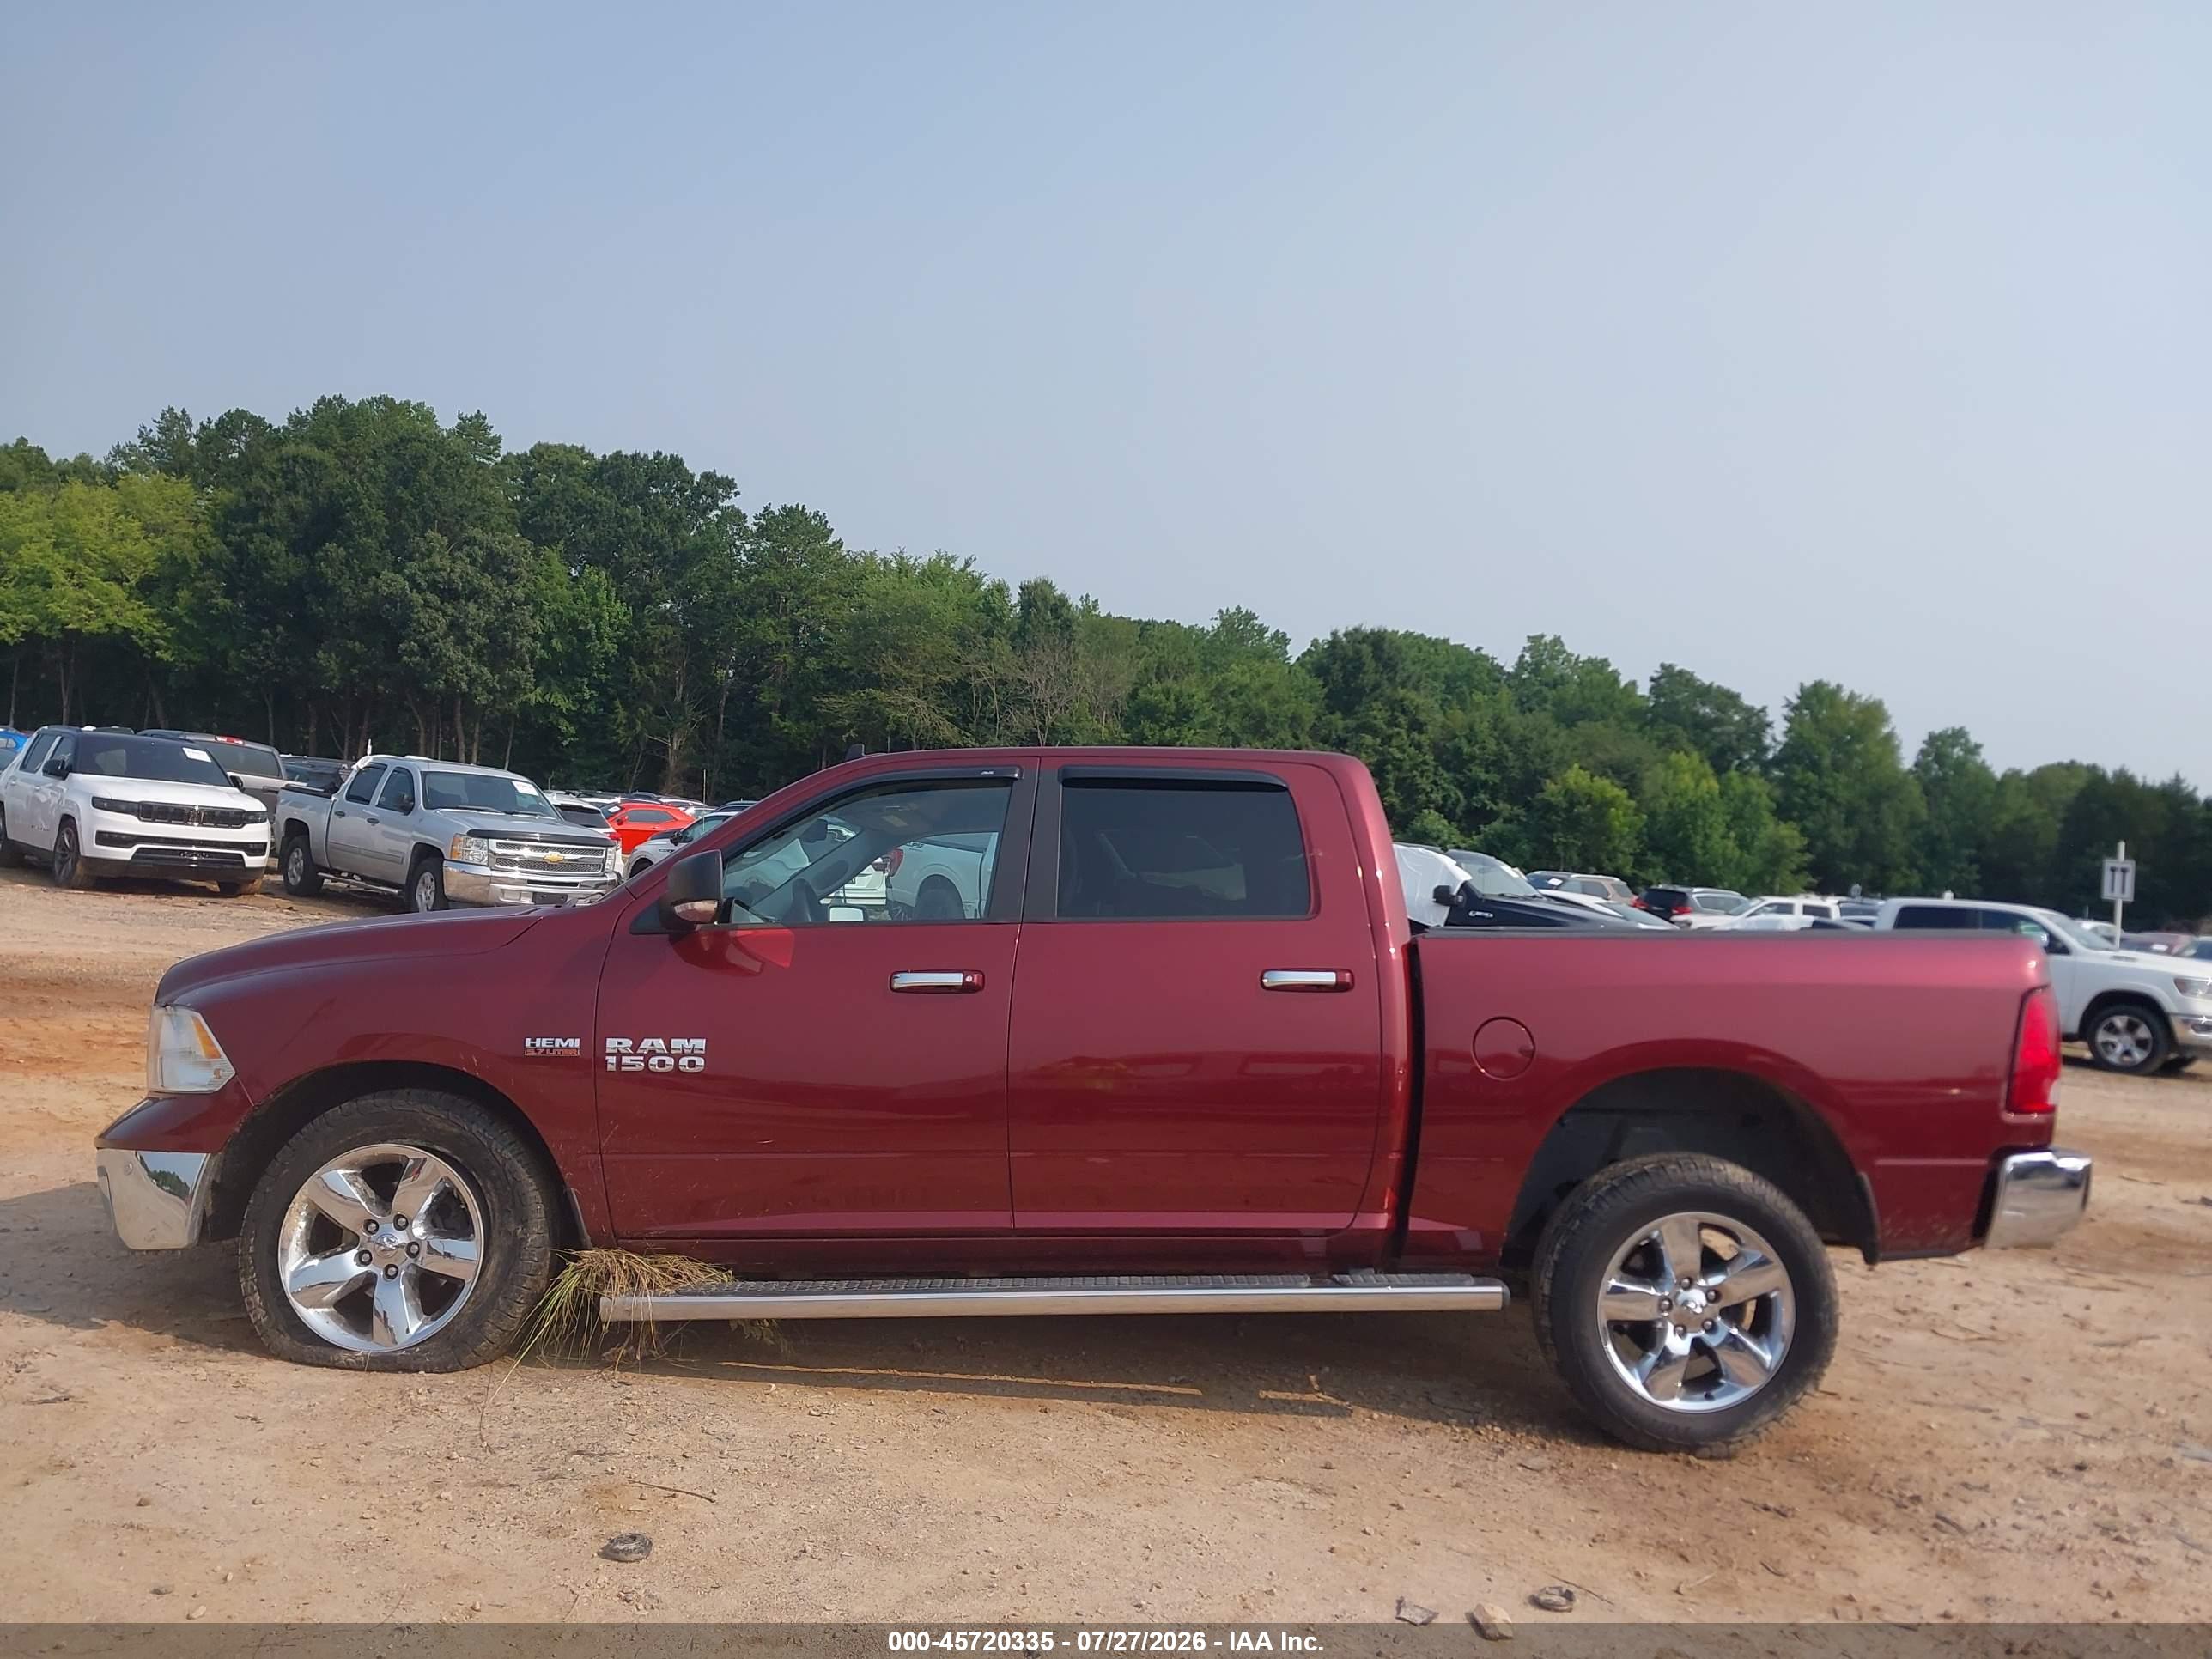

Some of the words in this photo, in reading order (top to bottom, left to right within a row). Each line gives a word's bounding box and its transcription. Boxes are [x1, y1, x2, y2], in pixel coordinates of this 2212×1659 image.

[525, 1037, 580, 1048] HEMI
[605, 1037, 707, 1054] RAM
[605, 1055, 706, 1073] 1500
